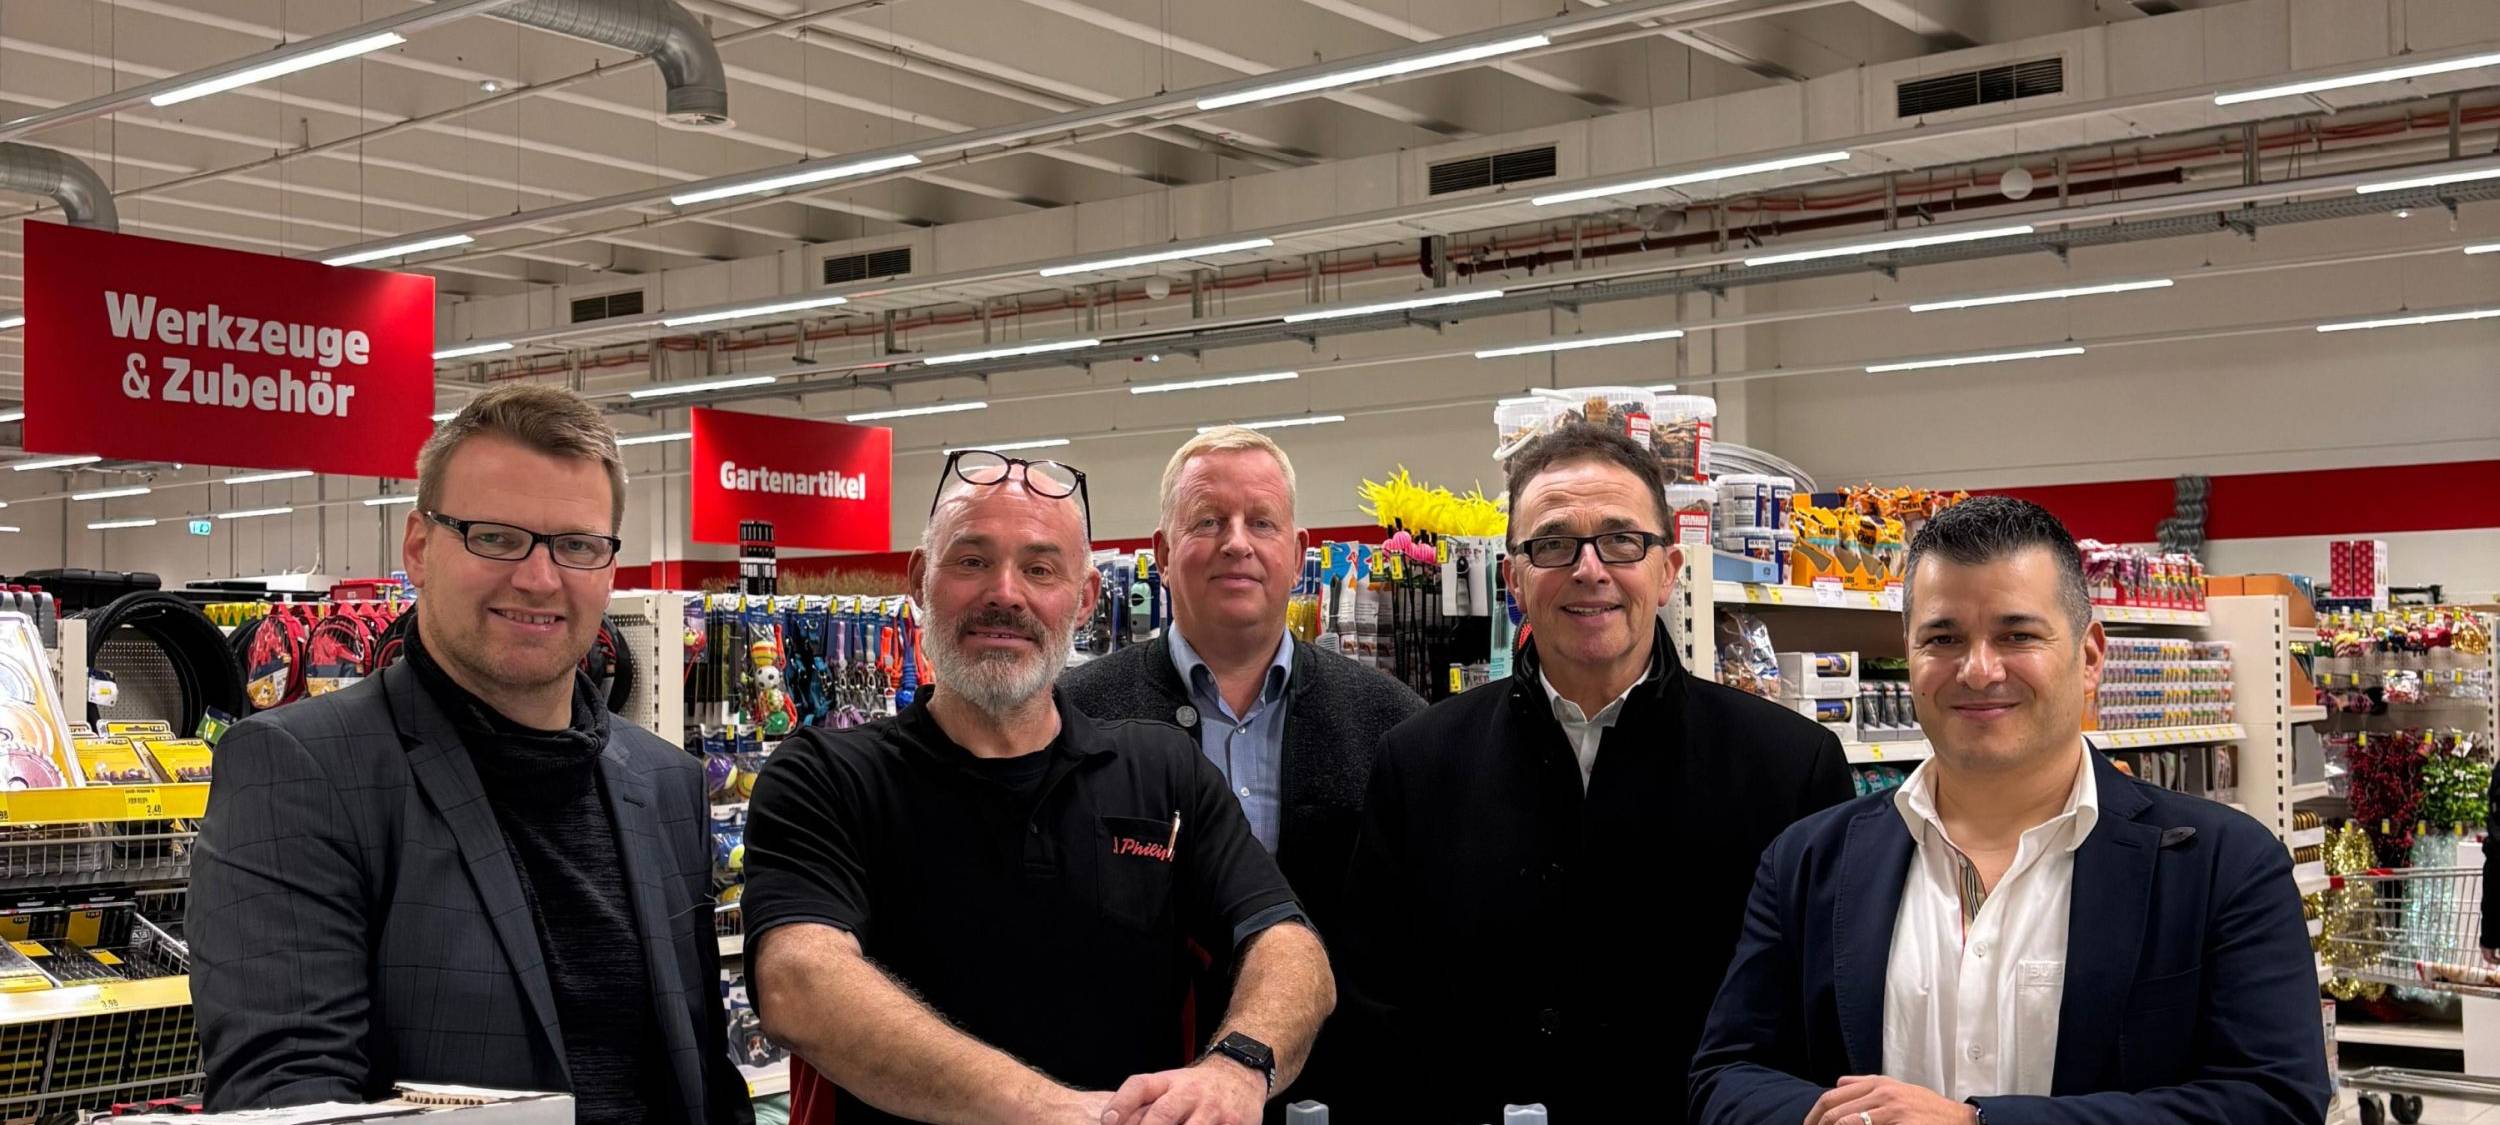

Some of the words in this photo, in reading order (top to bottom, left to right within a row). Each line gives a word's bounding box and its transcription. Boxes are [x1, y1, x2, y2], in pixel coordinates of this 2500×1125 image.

[105, 291, 370, 368] Werkzeuge
[122, 352, 151, 400] &
[162, 356, 355, 417] Zubehör
[720, 460, 866, 500] Gartenartikel
